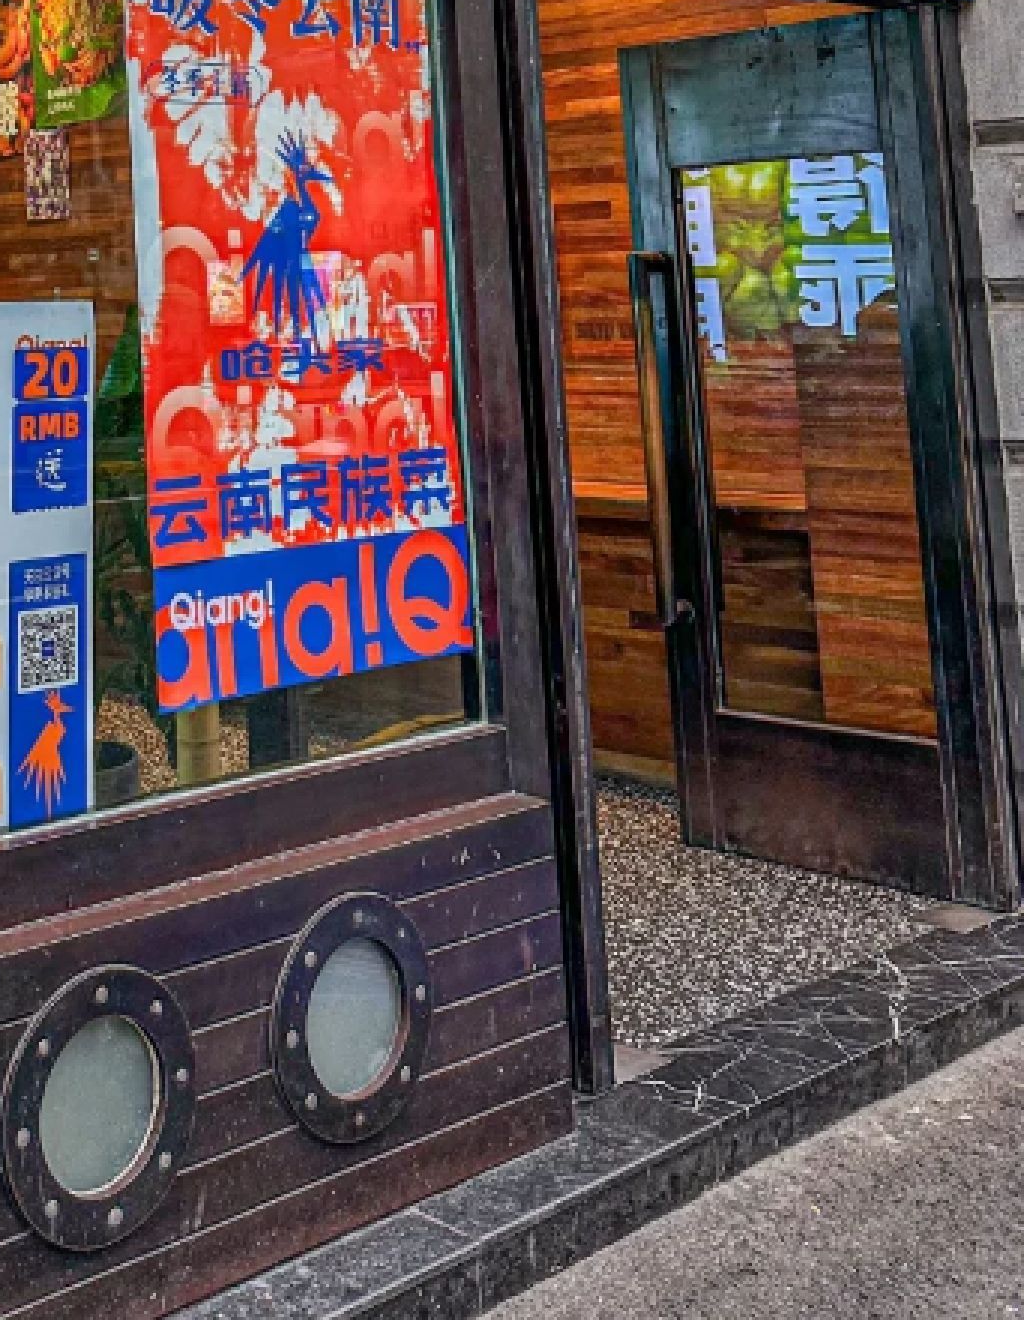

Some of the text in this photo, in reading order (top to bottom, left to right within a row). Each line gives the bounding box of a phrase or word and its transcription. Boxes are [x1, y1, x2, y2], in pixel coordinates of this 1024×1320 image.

[23, 349, 79, 399] 20
[20, 411, 79, 442] RMB
[150, 445, 451, 549] 云南民族菜
[169, 578, 275, 630] Qiang!
